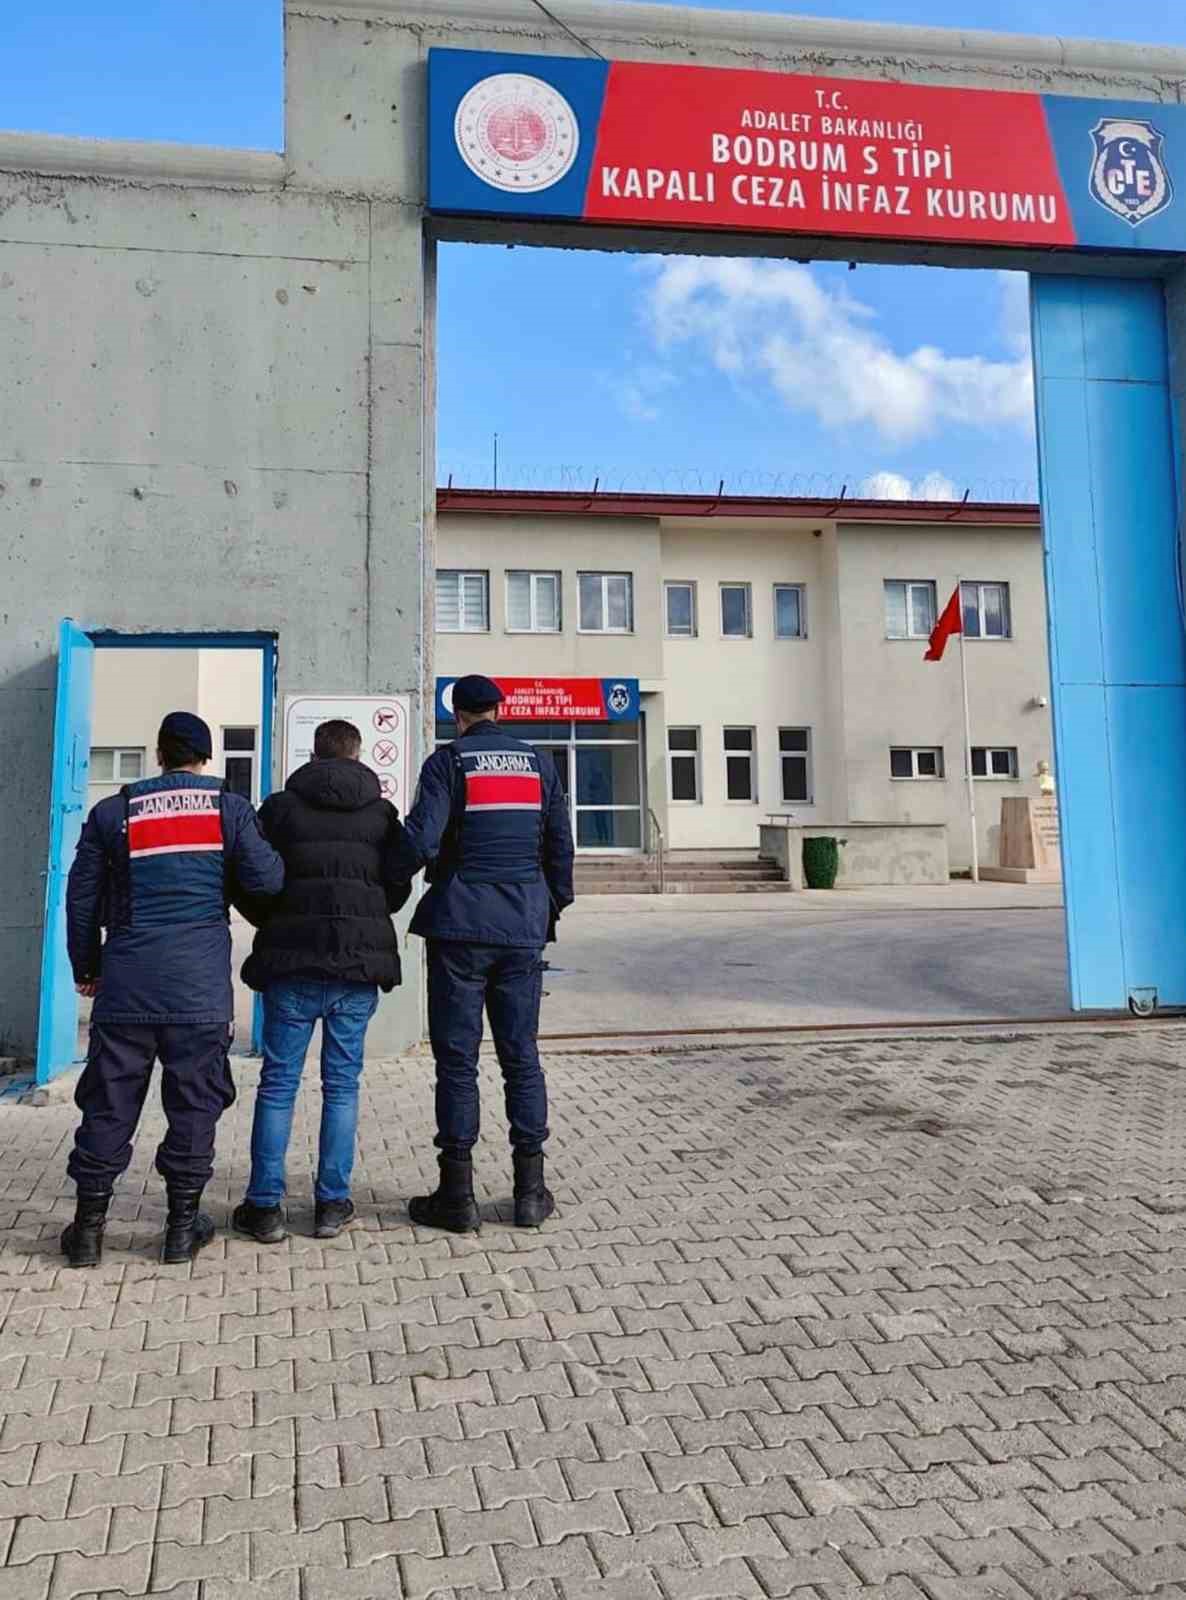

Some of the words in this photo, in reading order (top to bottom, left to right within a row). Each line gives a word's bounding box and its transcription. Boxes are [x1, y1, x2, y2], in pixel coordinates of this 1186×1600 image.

[815, 89, 849, 111] T.C.
[741, 109, 812, 133] ADALET
[821, 115, 923, 141] BAKANLIĞI
[712, 133, 847, 173] BODRUM
[862, 145, 879, 175] S
[892, 142, 953, 180] TİPİ
[602, 166, 715, 202] KAPALI
[731, 174, 806, 209] CEZA
[822, 174, 911, 215] İNFAZ
[926, 187, 1057, 224] KURUMU
[474, 753, 533, 772] JANDARMA
[138, 794, 213, 815] JANDARMA
